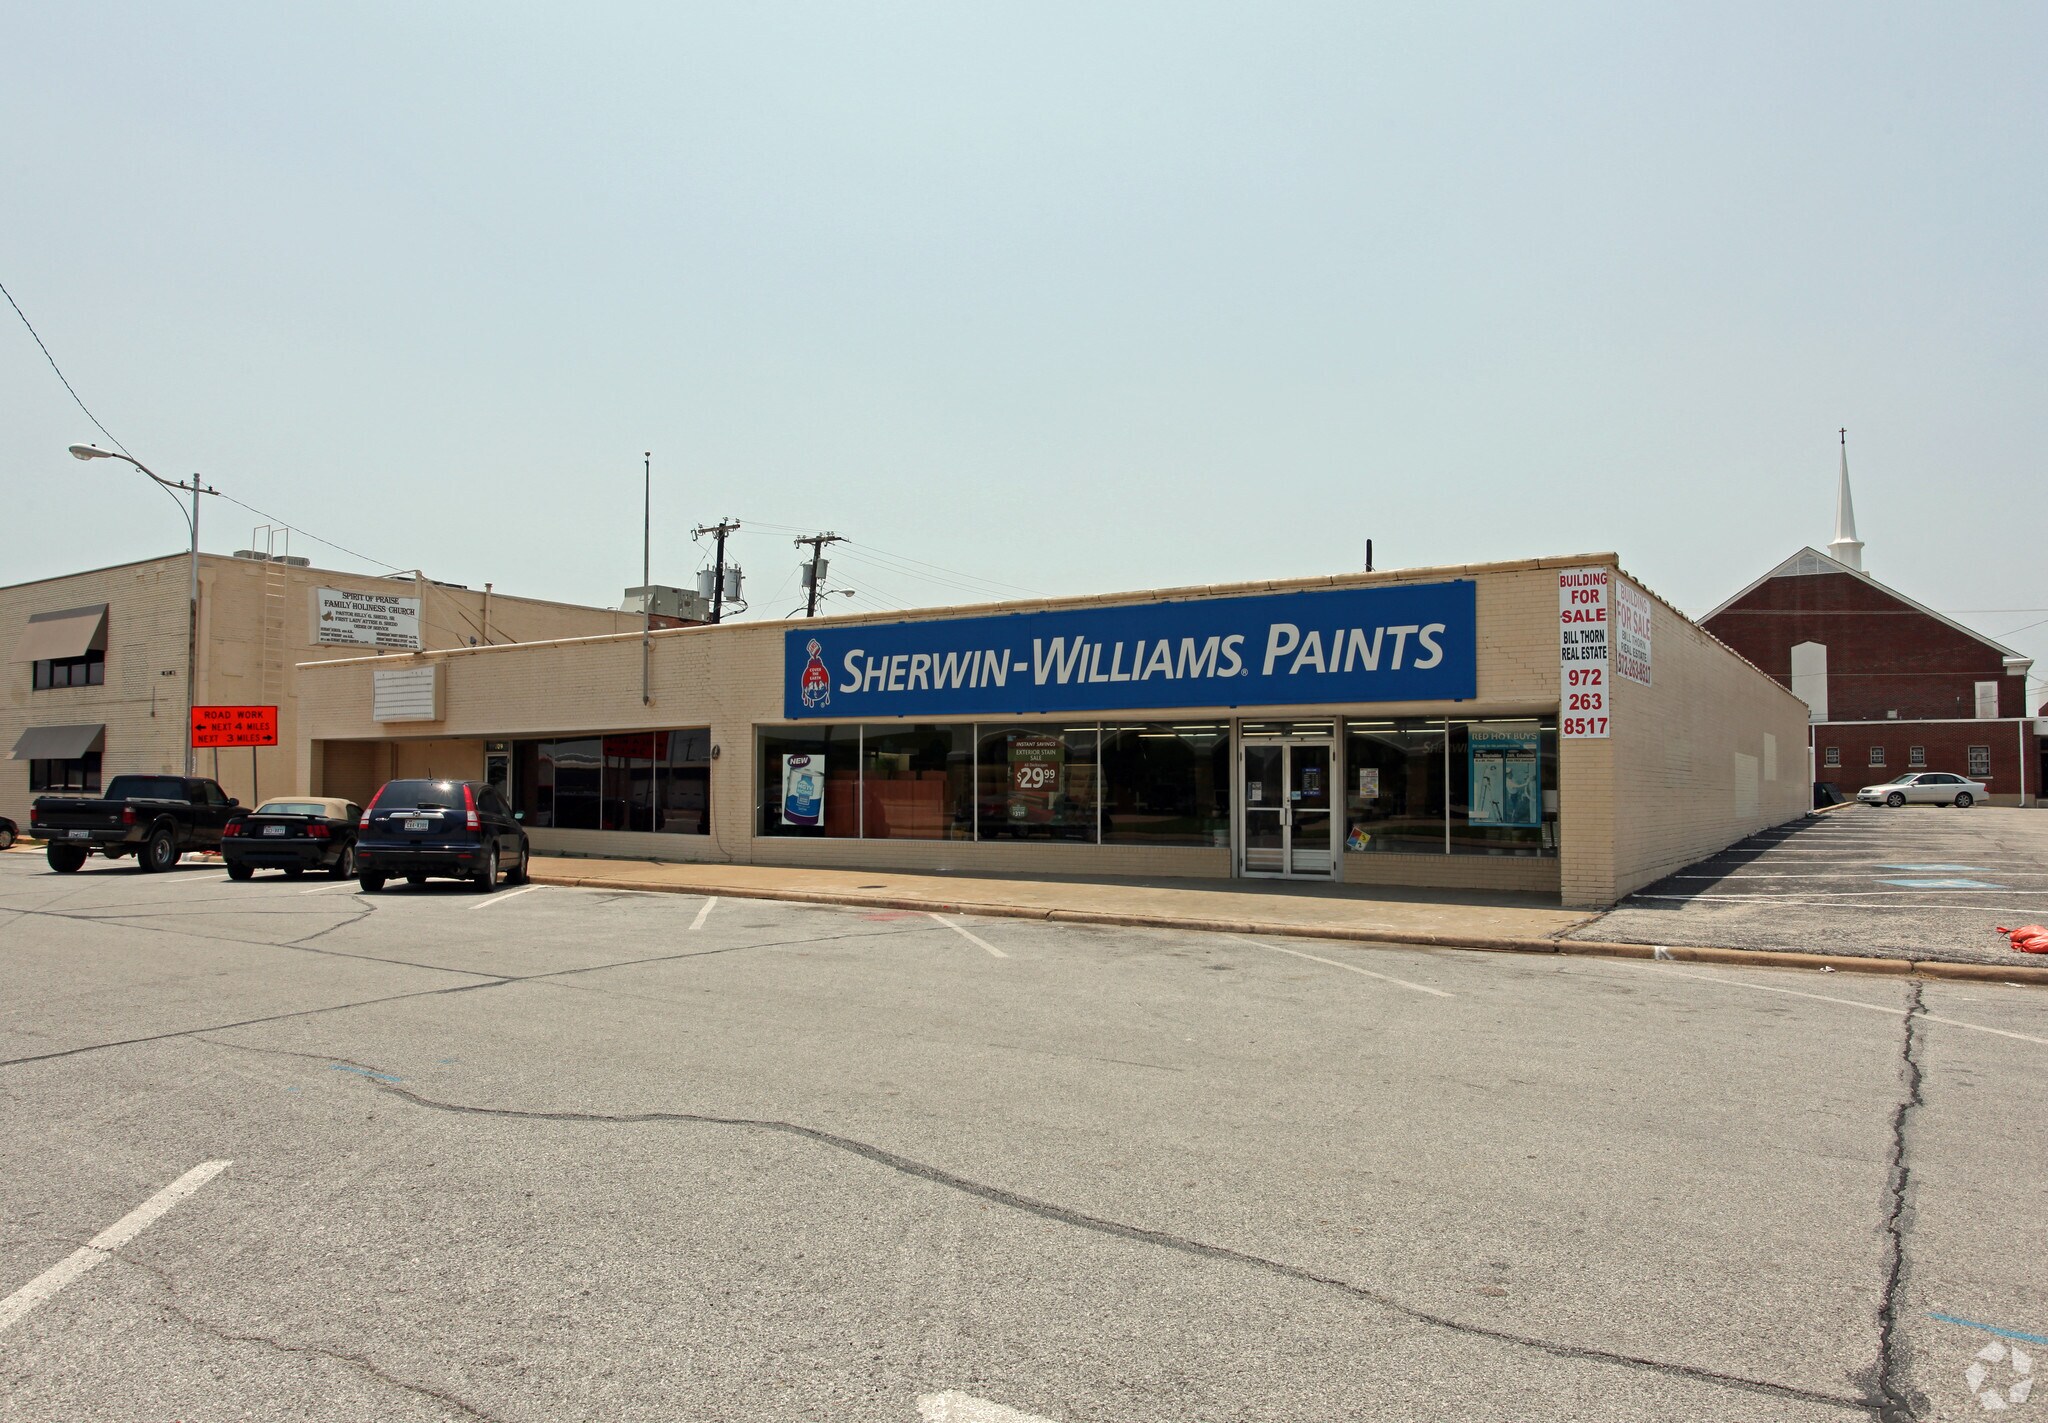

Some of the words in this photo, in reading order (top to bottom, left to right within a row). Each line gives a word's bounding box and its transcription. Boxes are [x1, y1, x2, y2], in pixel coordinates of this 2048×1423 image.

[1560, 572, 1608, 588] BUILDING
[342, 592, 363, 601] SPIRIT
[376, 596, 399, 604] PRAISE
[1571, 589, 1600, 604] FOR
[1620, 584, 1648, 613] BUILDING
[324, 600, 351, 610] FAMILY
[353, 602, 386, 613] HOLINESS
[388, 606, 415, 616] CHURCH
[1562, 608, 1606, 624] SALE
[1617, 601, 1631, 629] FOR
[1634, 612, 1650, 641] SALE
[1563, 630, 1579, 644] BILL
[1581, 630, 1604, 643] THORN
[1262, 622, 1446, 676] PAINTS
[1562, 647, 1580, 660] REAL
[1581, 646, 1607, 660] ESTATE
[1568, 669, 1602, 686] 972
[1569, 693, 1602, 710] 263
[204, 711, 231, 719] ROAD
[212, 723, 232, 731] NEXT
[1564, 718, 1608, 735] 8517
[227, 734, 234, 742] 3
[237, 734, 260, 742] MILES
[1514, 732, 1537, 740] BUYS
[790, 757, 808, 765] NEW
